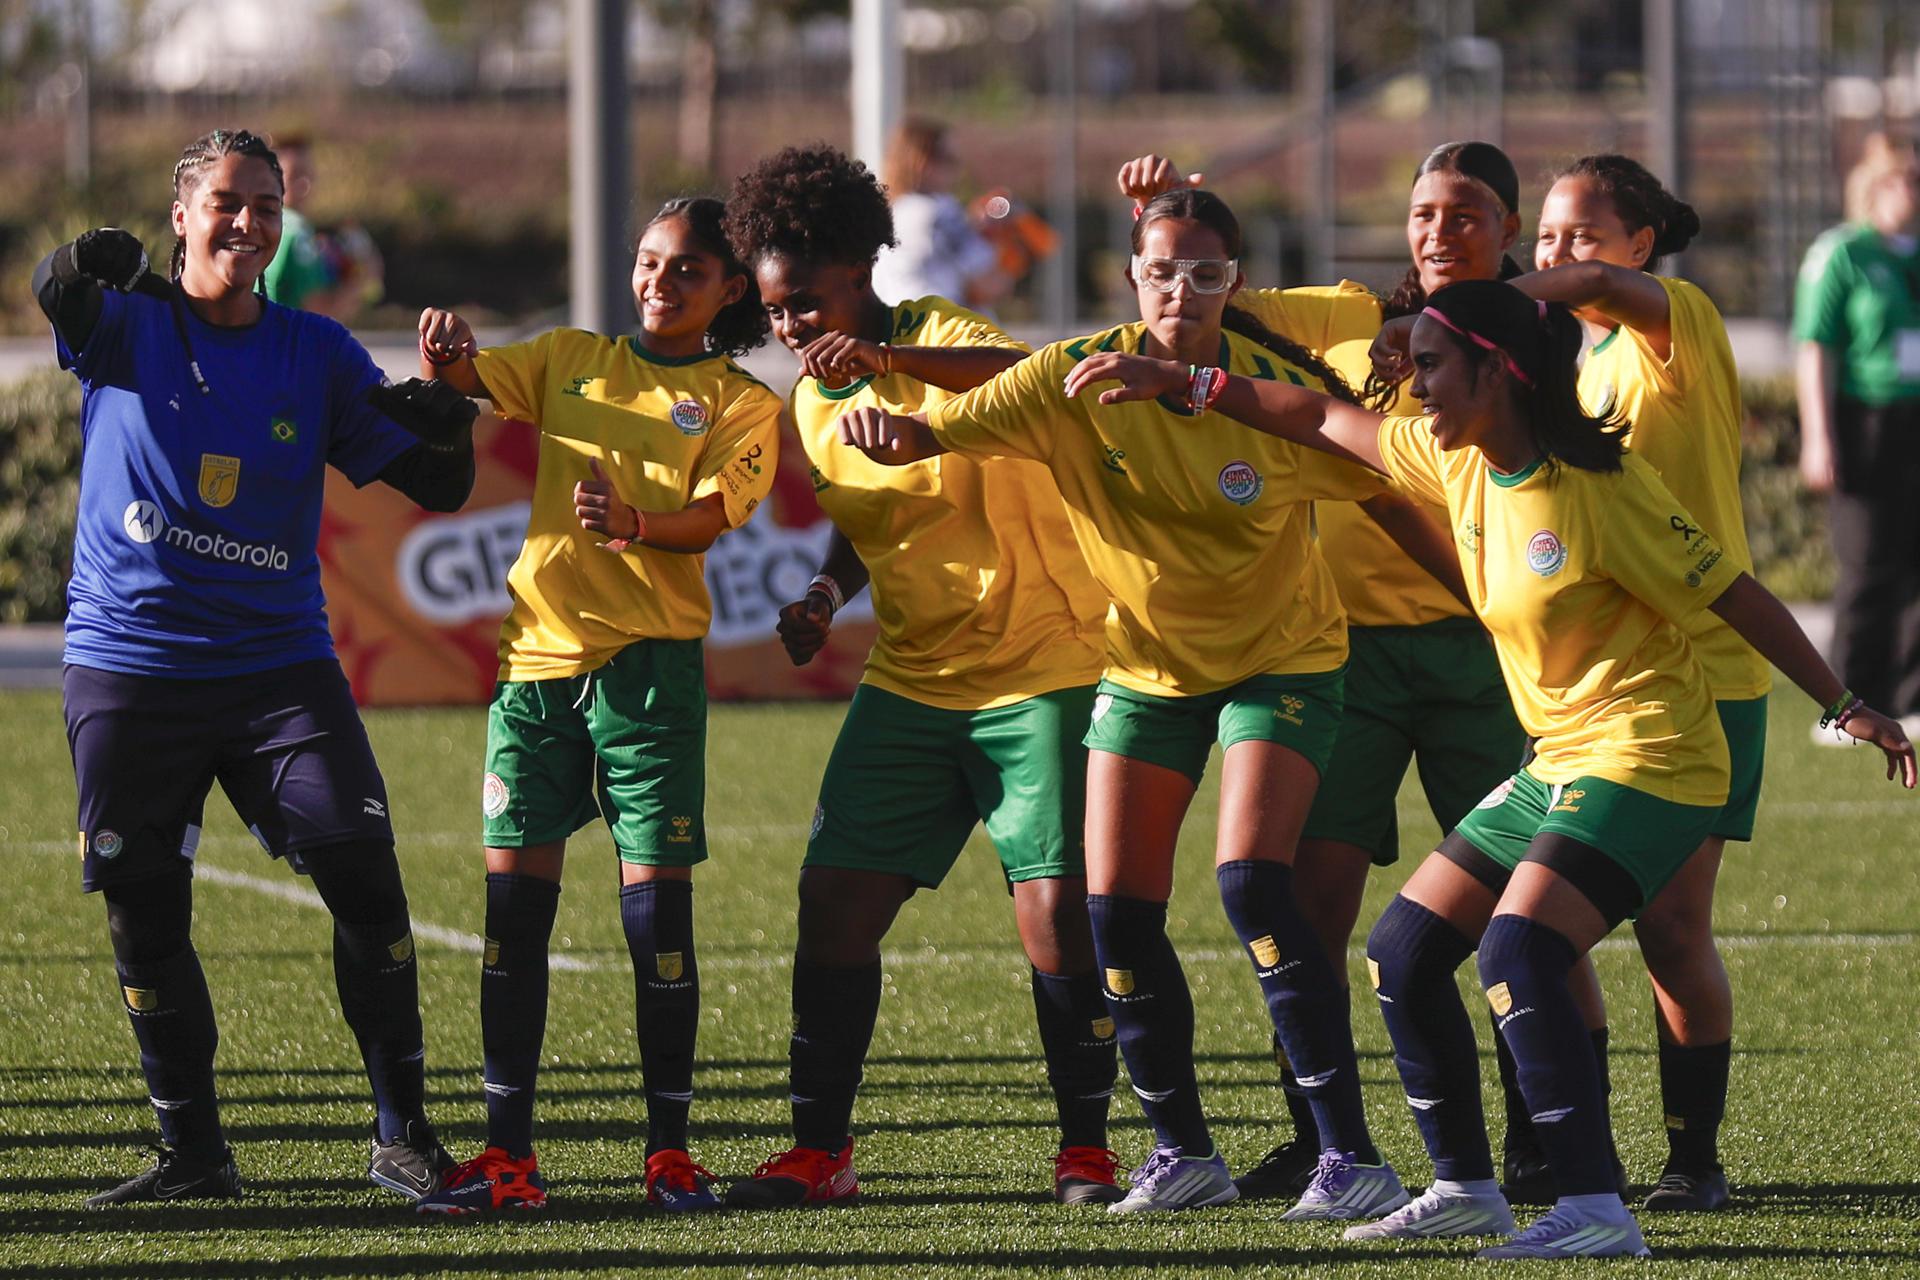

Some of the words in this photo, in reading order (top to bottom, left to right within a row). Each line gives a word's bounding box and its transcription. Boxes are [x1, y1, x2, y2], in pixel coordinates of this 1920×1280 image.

[1224, 472, 1253, 484] CHILD
[165, 526, 288, 571] motorola
[1531, 542, 1557, 554] CHILD
